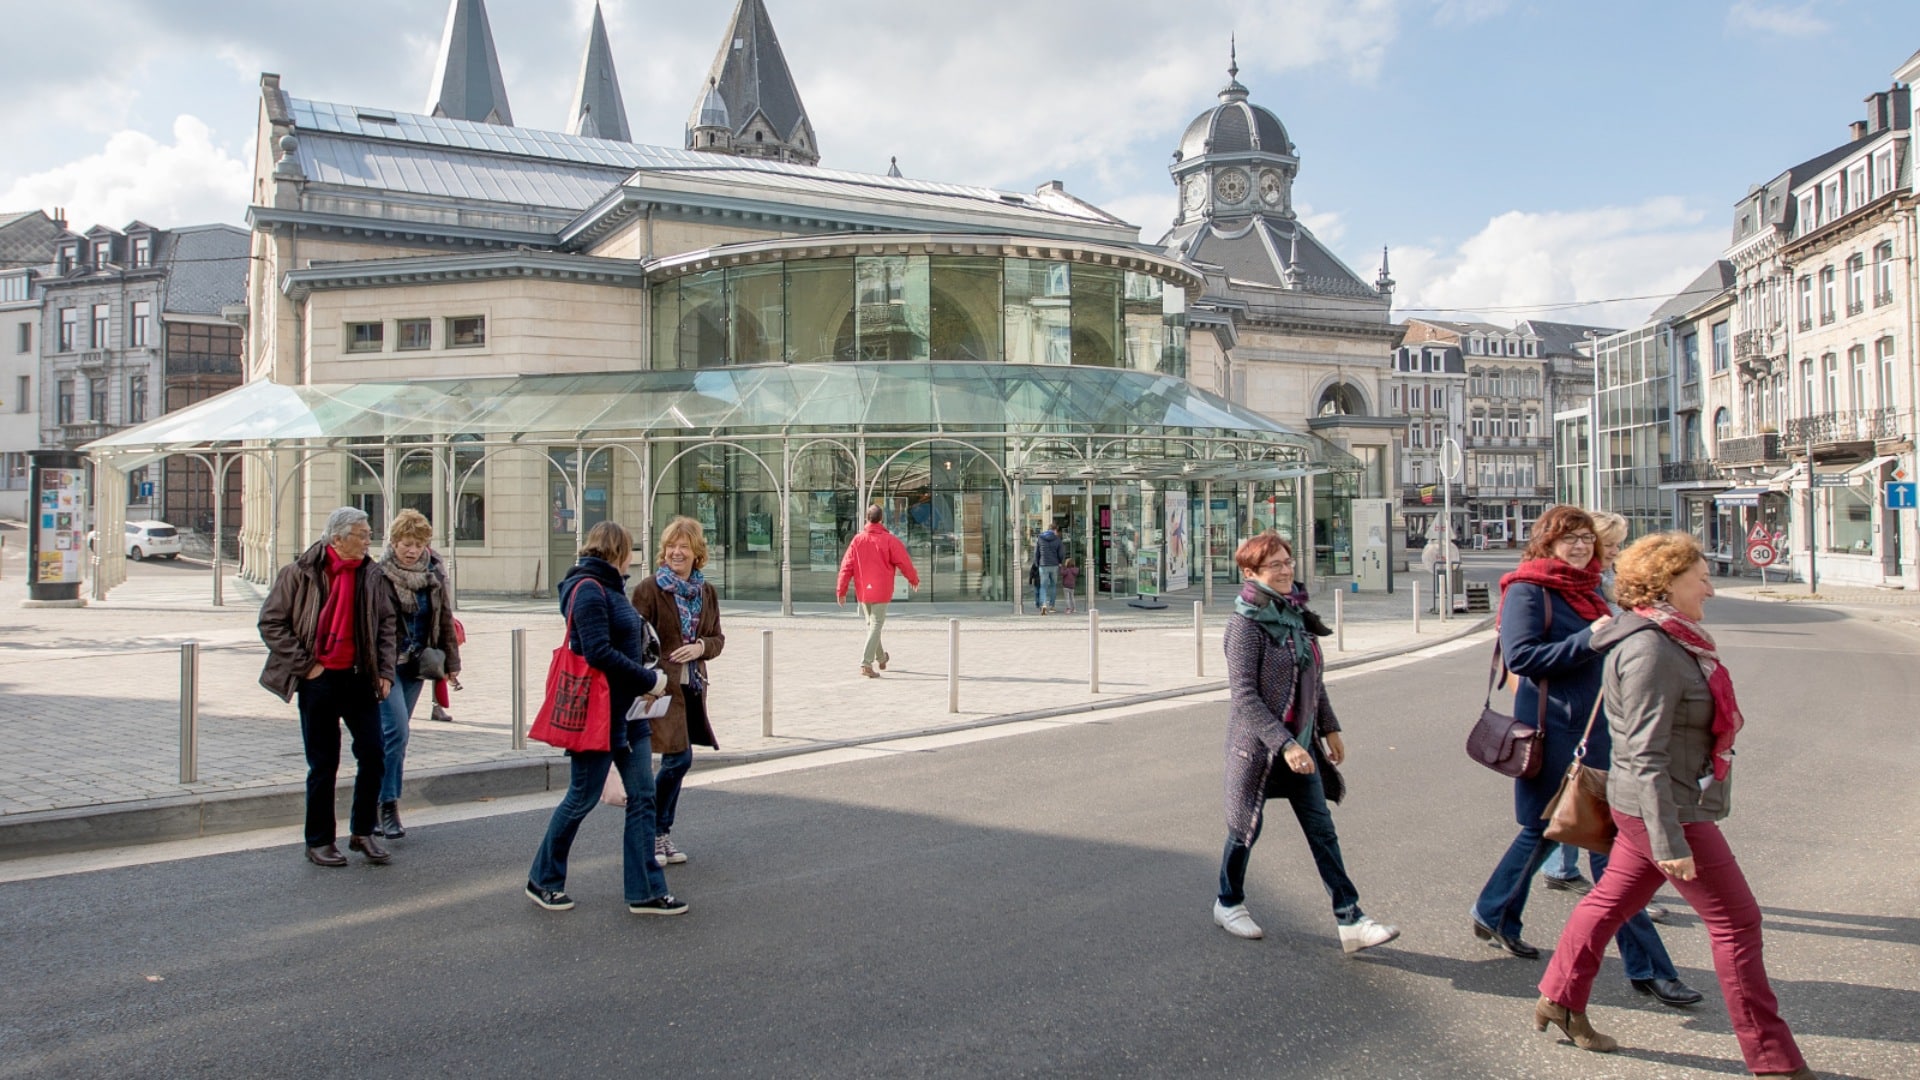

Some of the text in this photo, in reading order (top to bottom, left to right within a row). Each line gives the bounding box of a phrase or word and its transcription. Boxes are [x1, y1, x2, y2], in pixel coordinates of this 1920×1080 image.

[1753, 549, 1770, 559] 30
[558, 675, 592, 695] LET'S
[555, 690, 590, 710] OPEN
